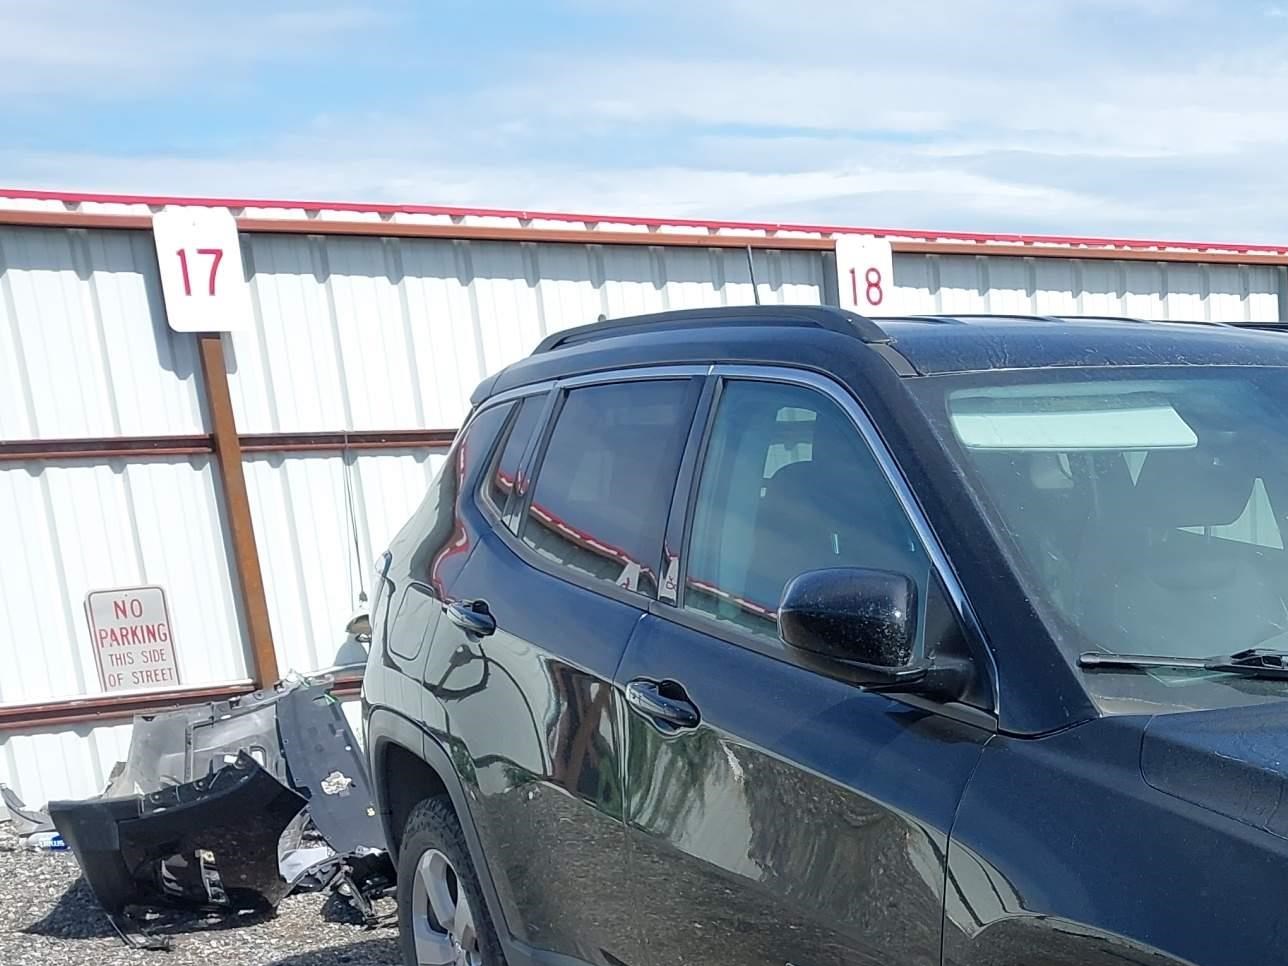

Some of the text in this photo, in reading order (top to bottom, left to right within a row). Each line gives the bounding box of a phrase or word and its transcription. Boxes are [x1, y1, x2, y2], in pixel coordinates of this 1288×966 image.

[176, 248, 223, 296] 17
[849, 267, 883, 306] 18
[113, 598, 143, 620] NO
[98, 623, 168, 648] PARKING
[109, 648, 167, 667] THIS SIDE
[108, 667, 174, 687] OF STREET
